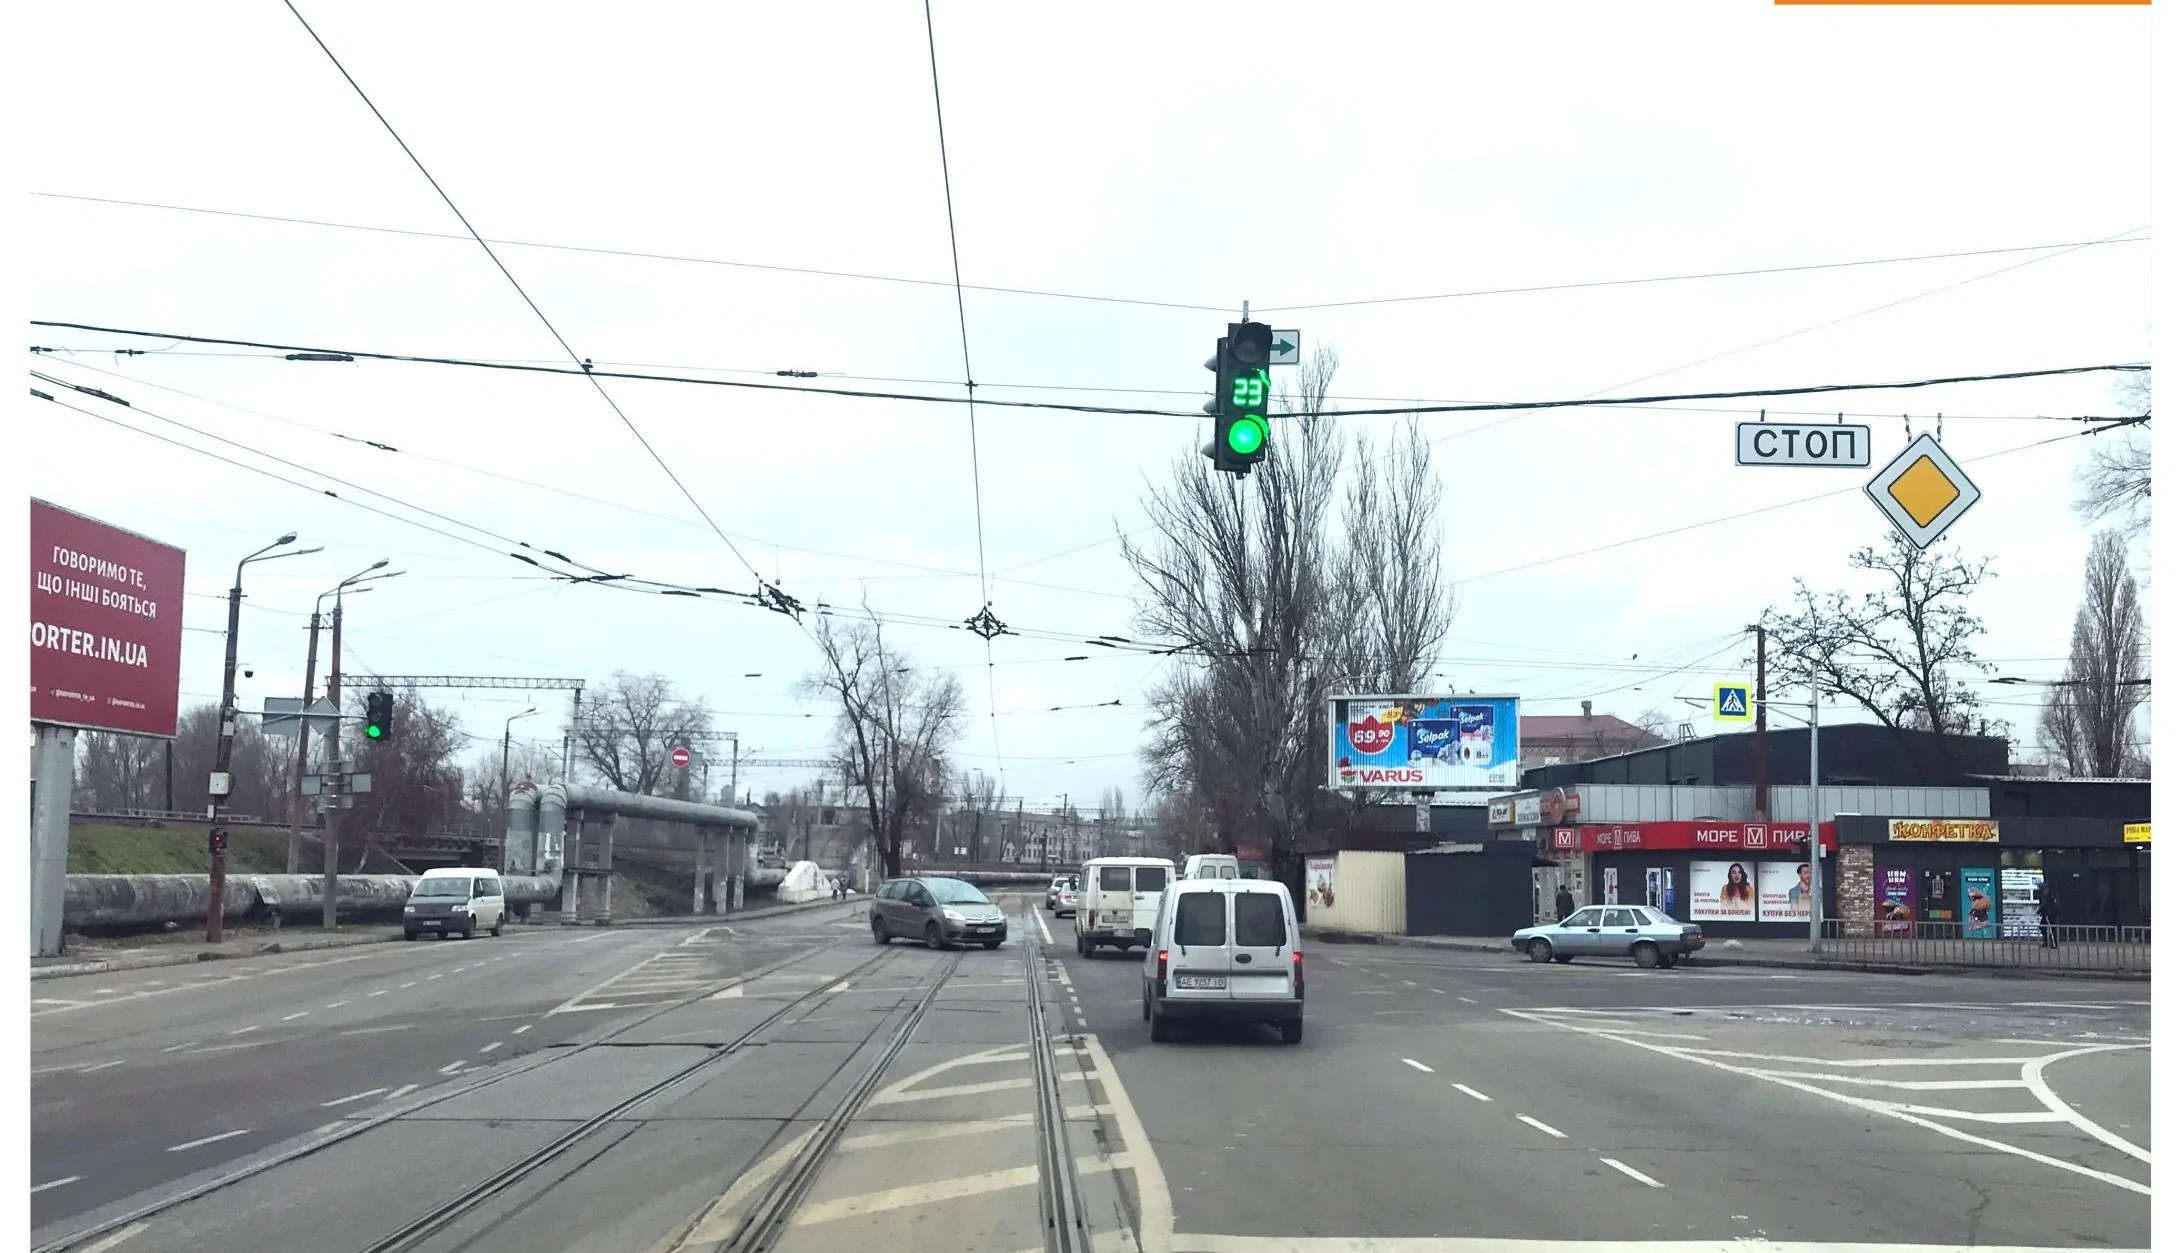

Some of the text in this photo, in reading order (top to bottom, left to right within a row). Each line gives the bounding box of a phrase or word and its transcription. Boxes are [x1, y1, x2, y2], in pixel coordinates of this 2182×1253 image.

[1233, 378, 1262, 405] 23
[1753, 429, 1856, 459] СТОП
[52, 546, 148, 591] ГОВОРИМО ТЕ,
[37, 571, 157, 618] ЩО ІНШІ БОЯТЬСЯ
[30, 621, 148, 668] ORTER.IN.UA
[1460, 712, 1484, 724] Selpak
[1418, 729, 1450, 744] Selpak
[1360, 769, 1423, 783] VARUS
[1697, 830, 1738, 842] МОРЕ
[1896, 822, 1994, 839] КОНФЕТКА
[1763, 909, 1783, 917] КУПУЙ
